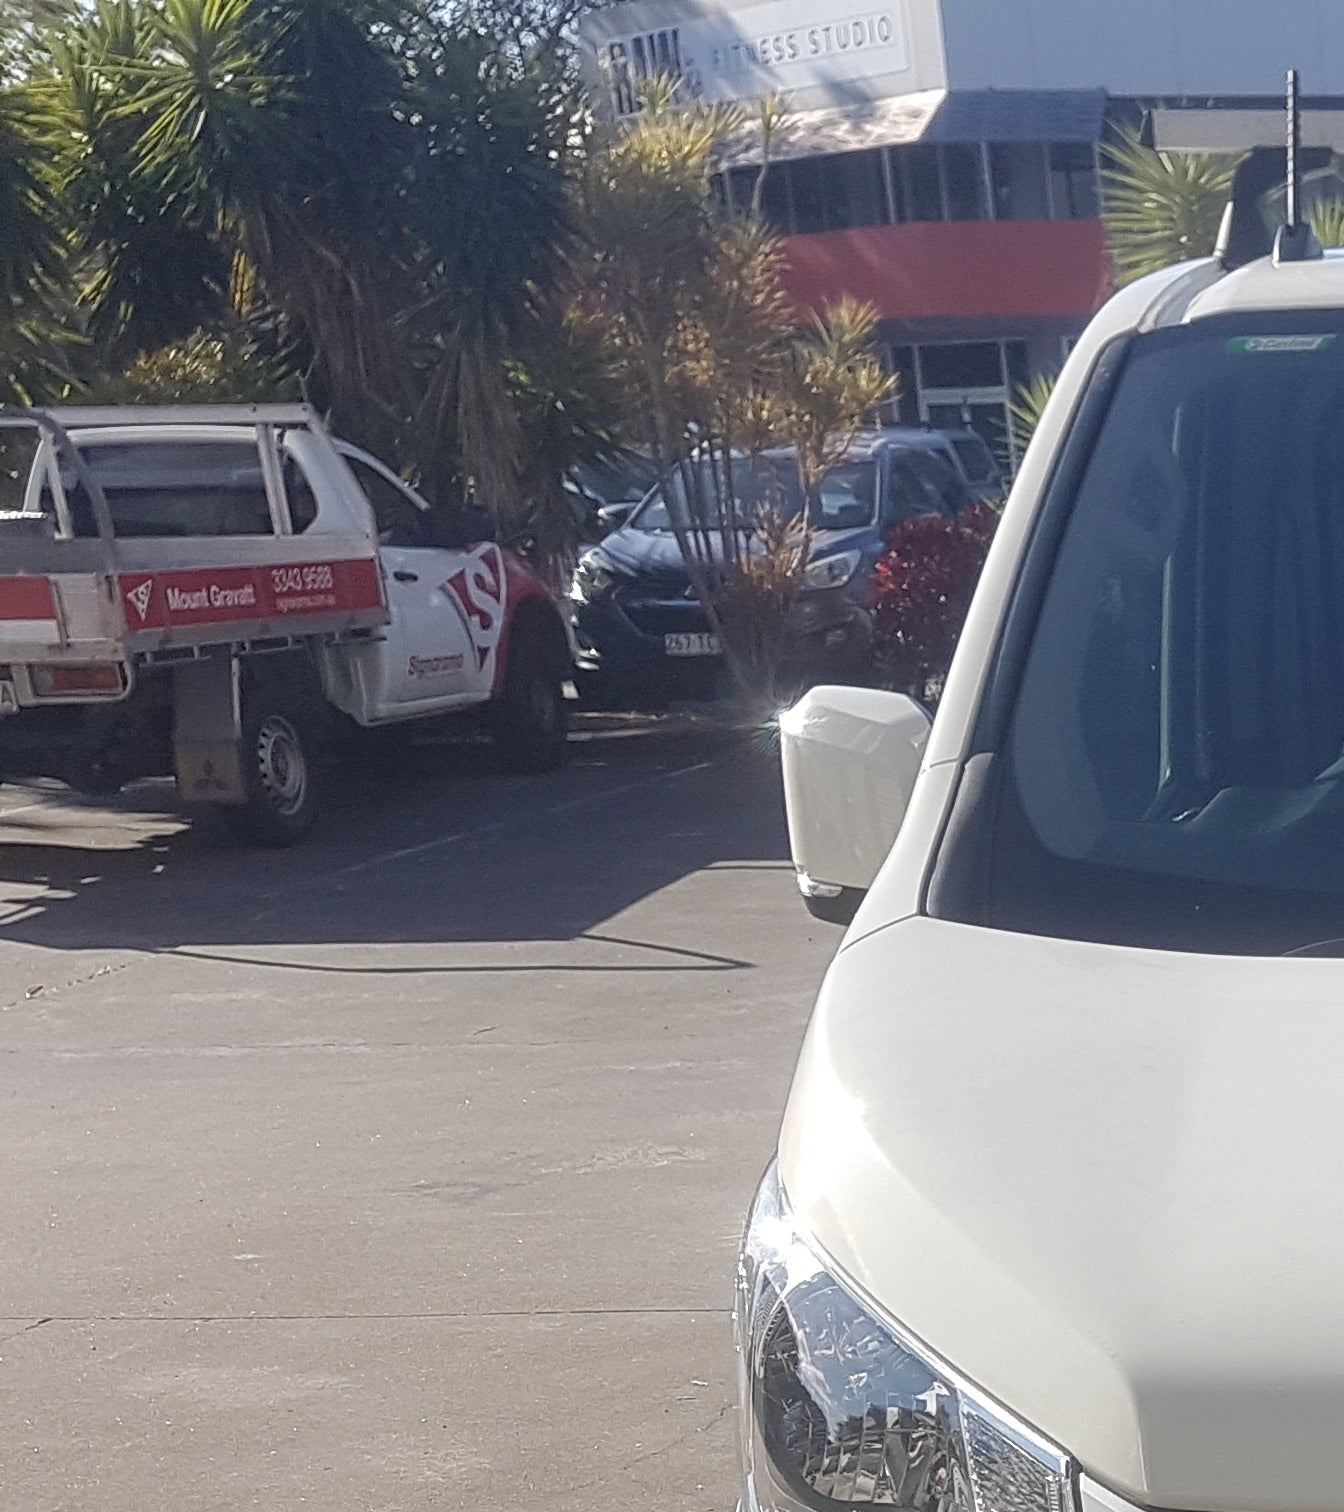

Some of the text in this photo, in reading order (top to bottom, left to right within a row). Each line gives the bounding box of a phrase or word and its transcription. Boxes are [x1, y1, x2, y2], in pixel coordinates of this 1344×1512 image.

[807, 15, 893, 55] STUDIO
[166, 587, 210, 611] Mount
[210, 583, 257, 608] Gravatt
